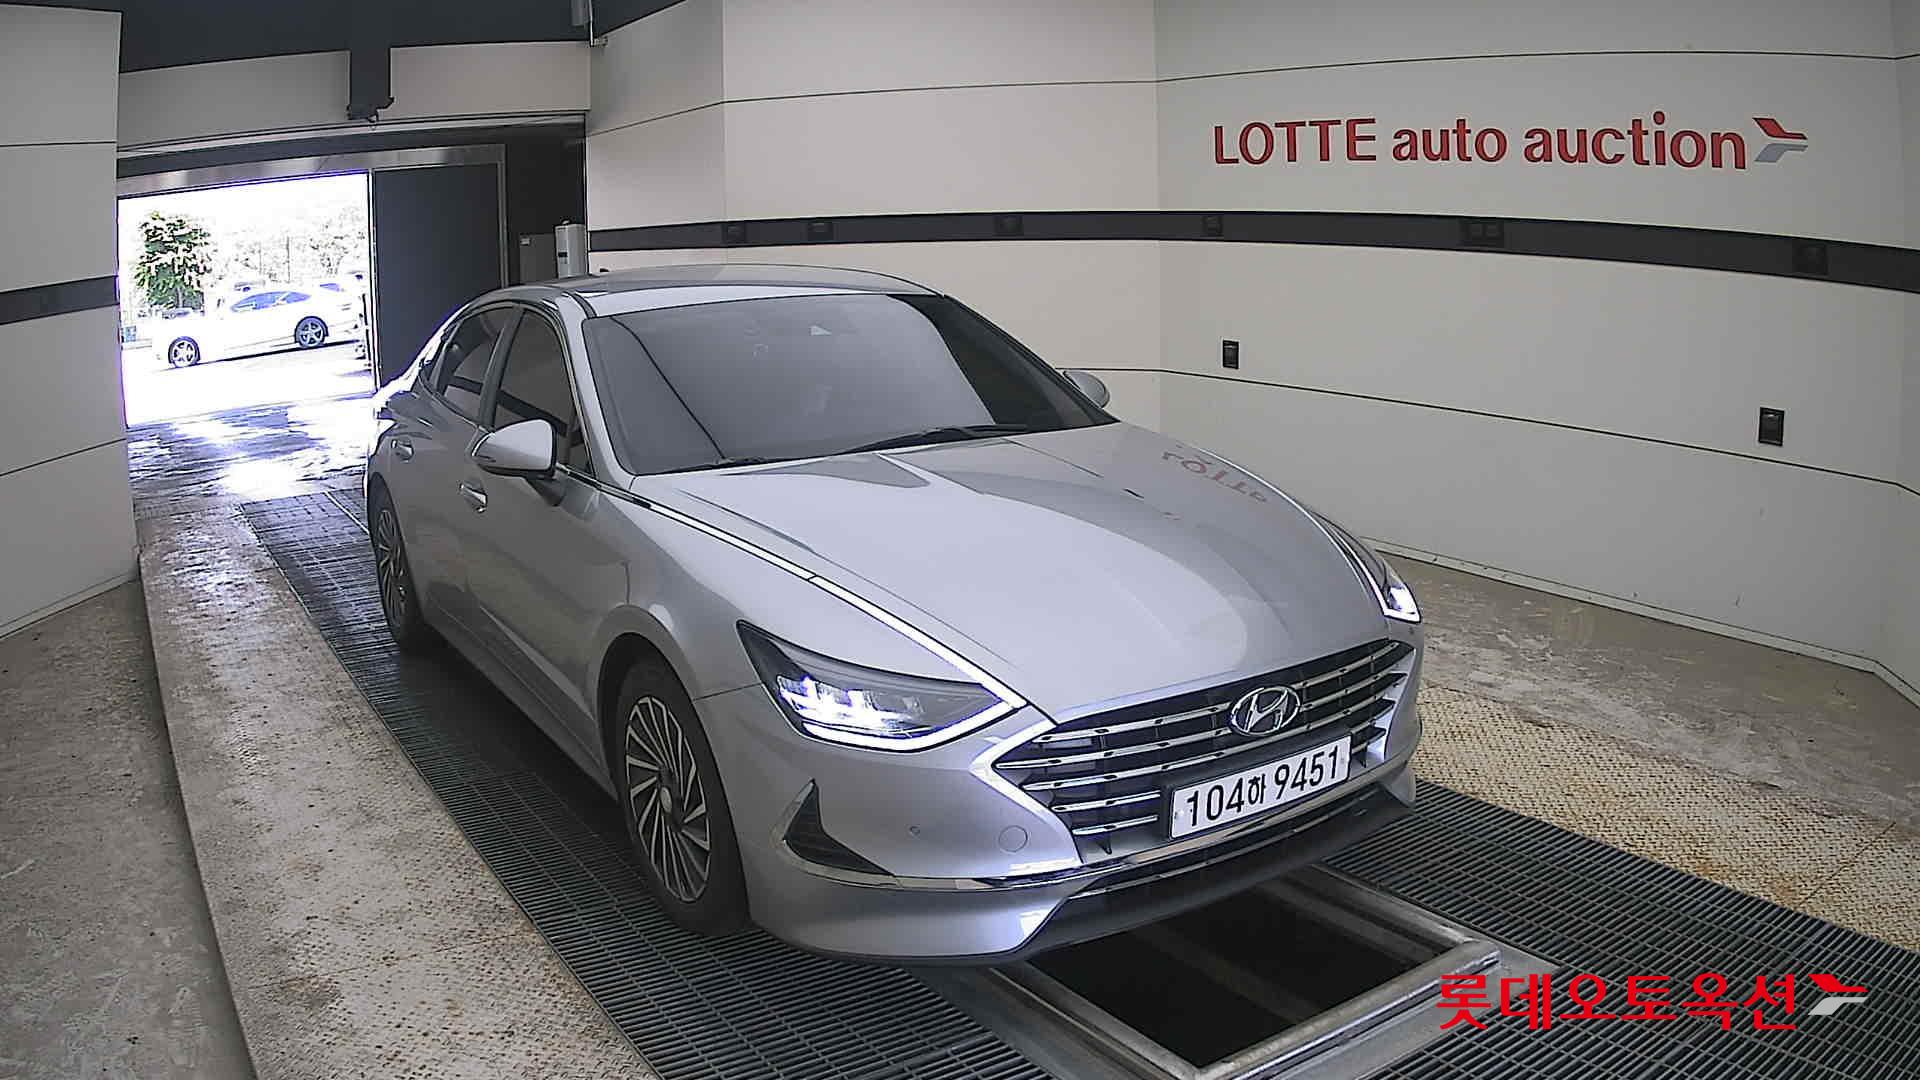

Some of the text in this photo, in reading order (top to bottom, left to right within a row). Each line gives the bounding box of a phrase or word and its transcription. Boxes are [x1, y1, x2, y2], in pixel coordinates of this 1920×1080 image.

[1214, 111, 1747, 170] LOTTE auto auction
[1187, 745, 1338, 827] 104하 9451
